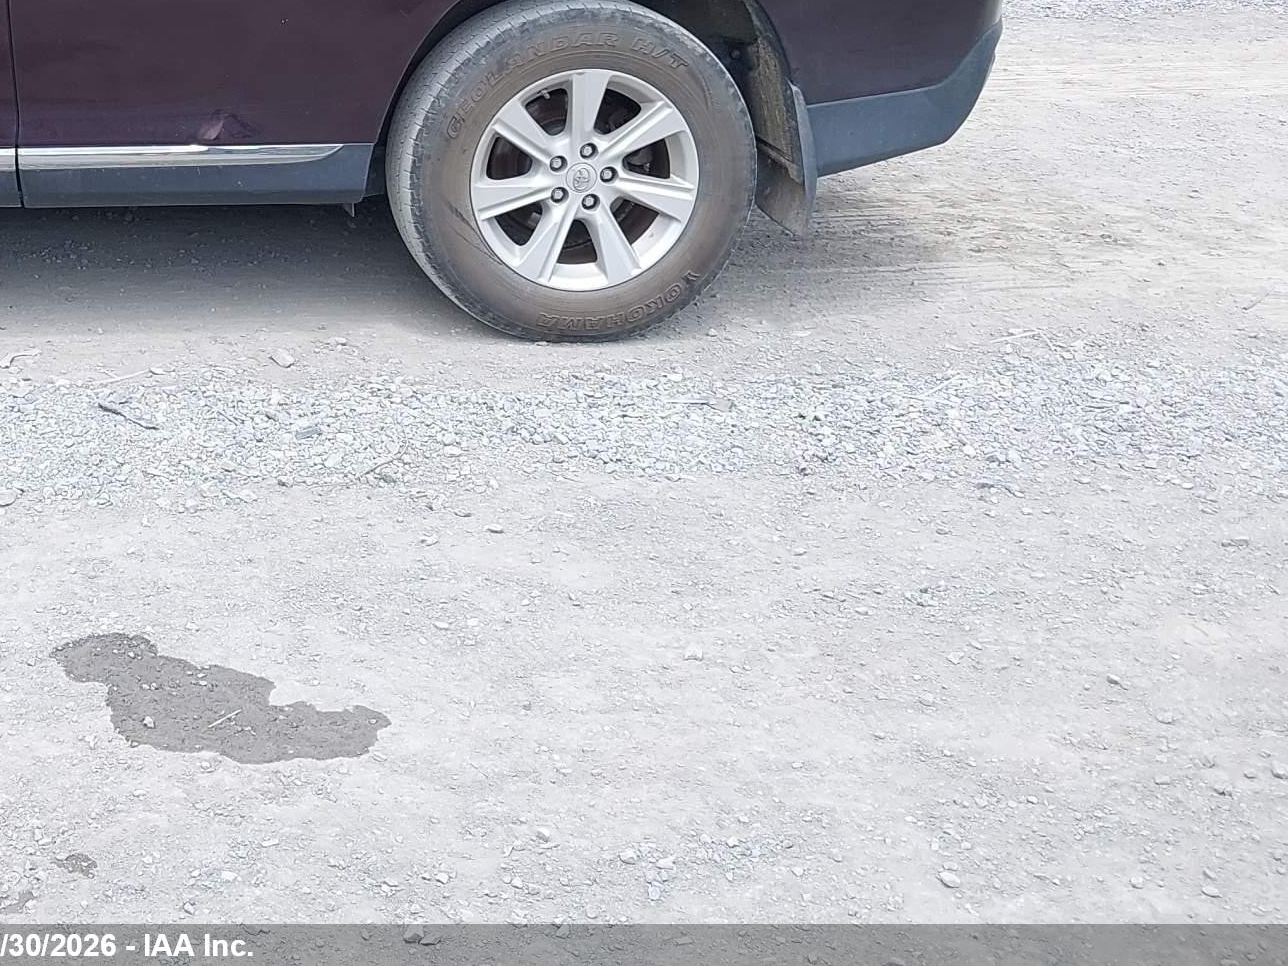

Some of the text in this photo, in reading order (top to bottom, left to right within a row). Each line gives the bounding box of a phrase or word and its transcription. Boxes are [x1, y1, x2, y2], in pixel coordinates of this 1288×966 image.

[445, 32, 689, 141] GEOLANDAR H/T
[535, 269, 701, 331] YOKOHAMA
